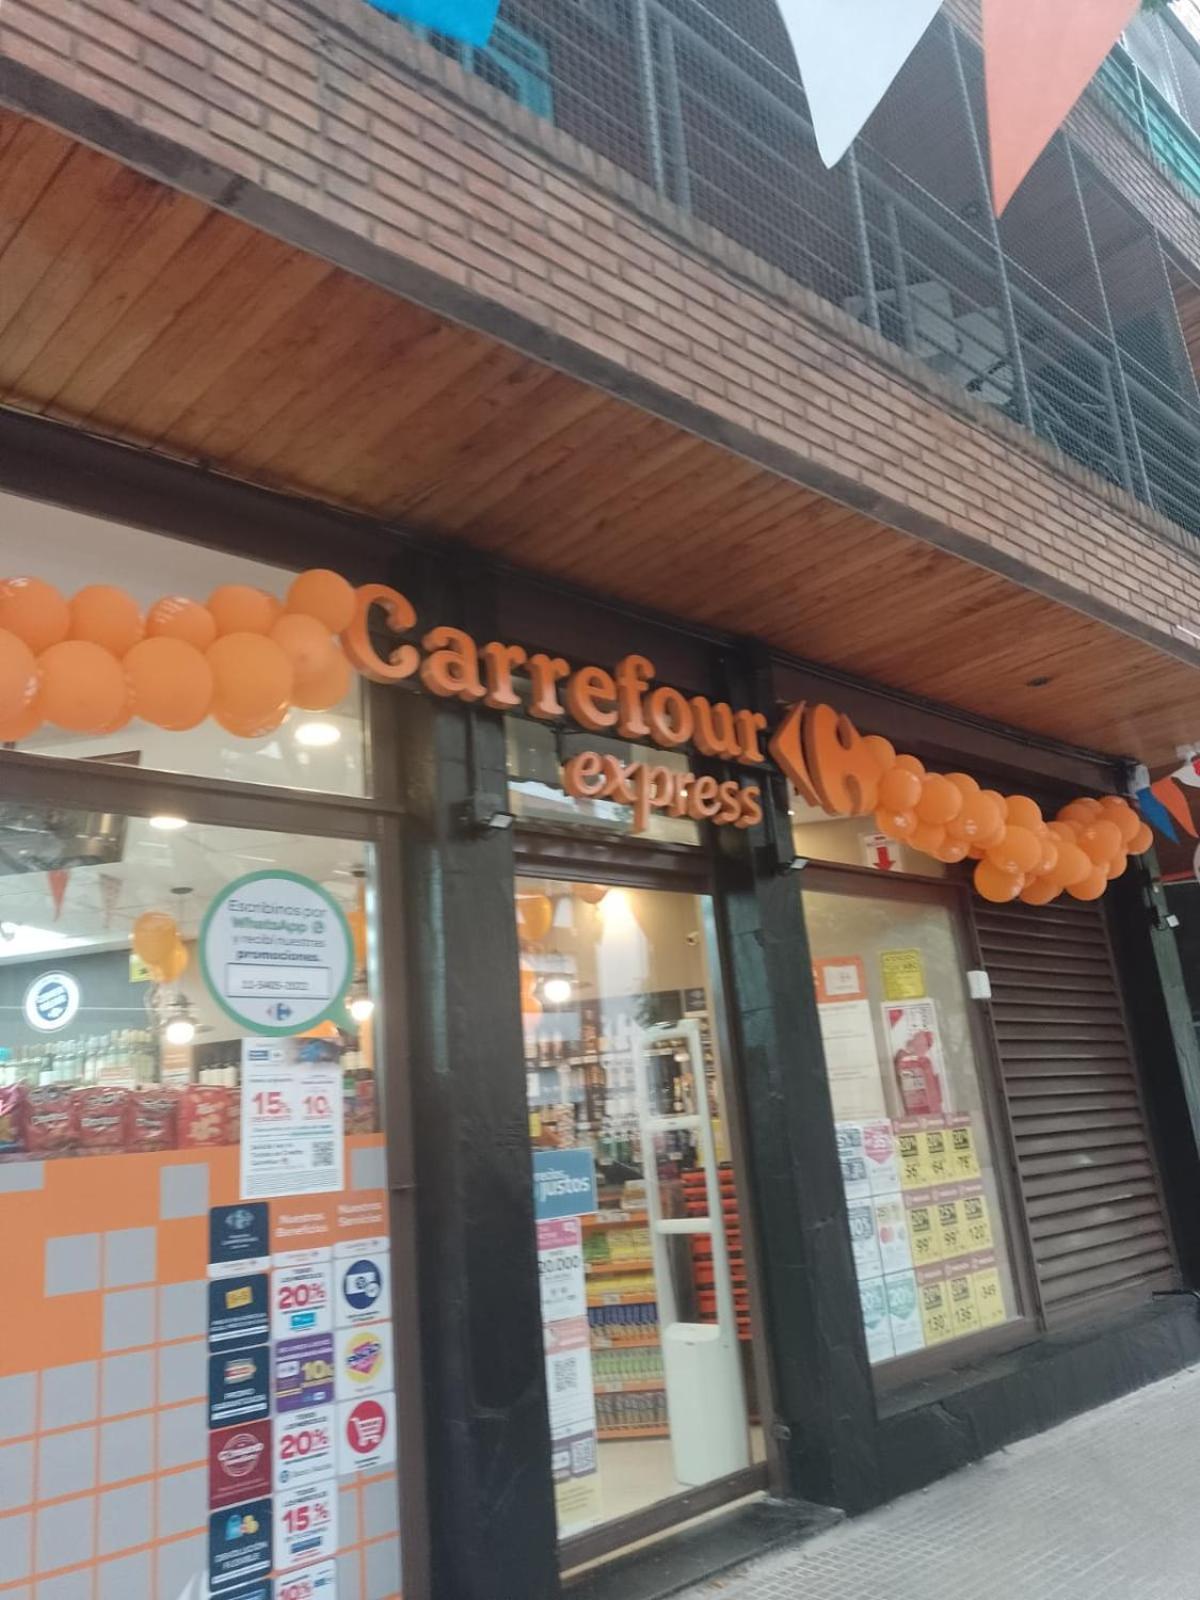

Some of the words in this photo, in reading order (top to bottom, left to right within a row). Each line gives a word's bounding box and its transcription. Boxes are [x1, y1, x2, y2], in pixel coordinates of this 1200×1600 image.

[341, 583, 767, 763] Carrefour
[563, 751, 762, 834] express
[228, 899, 300, 917] Escribinos
[302, 907, 327, 919] por
[231, 916, 306, 933] WhatsApp
[539, 1176, 591, 1203] justos
[278, 1281, 327, 1310] 20%
[280, 1427, 329, 1460] 20%
[282, 1502, 330, 1534] 15%
